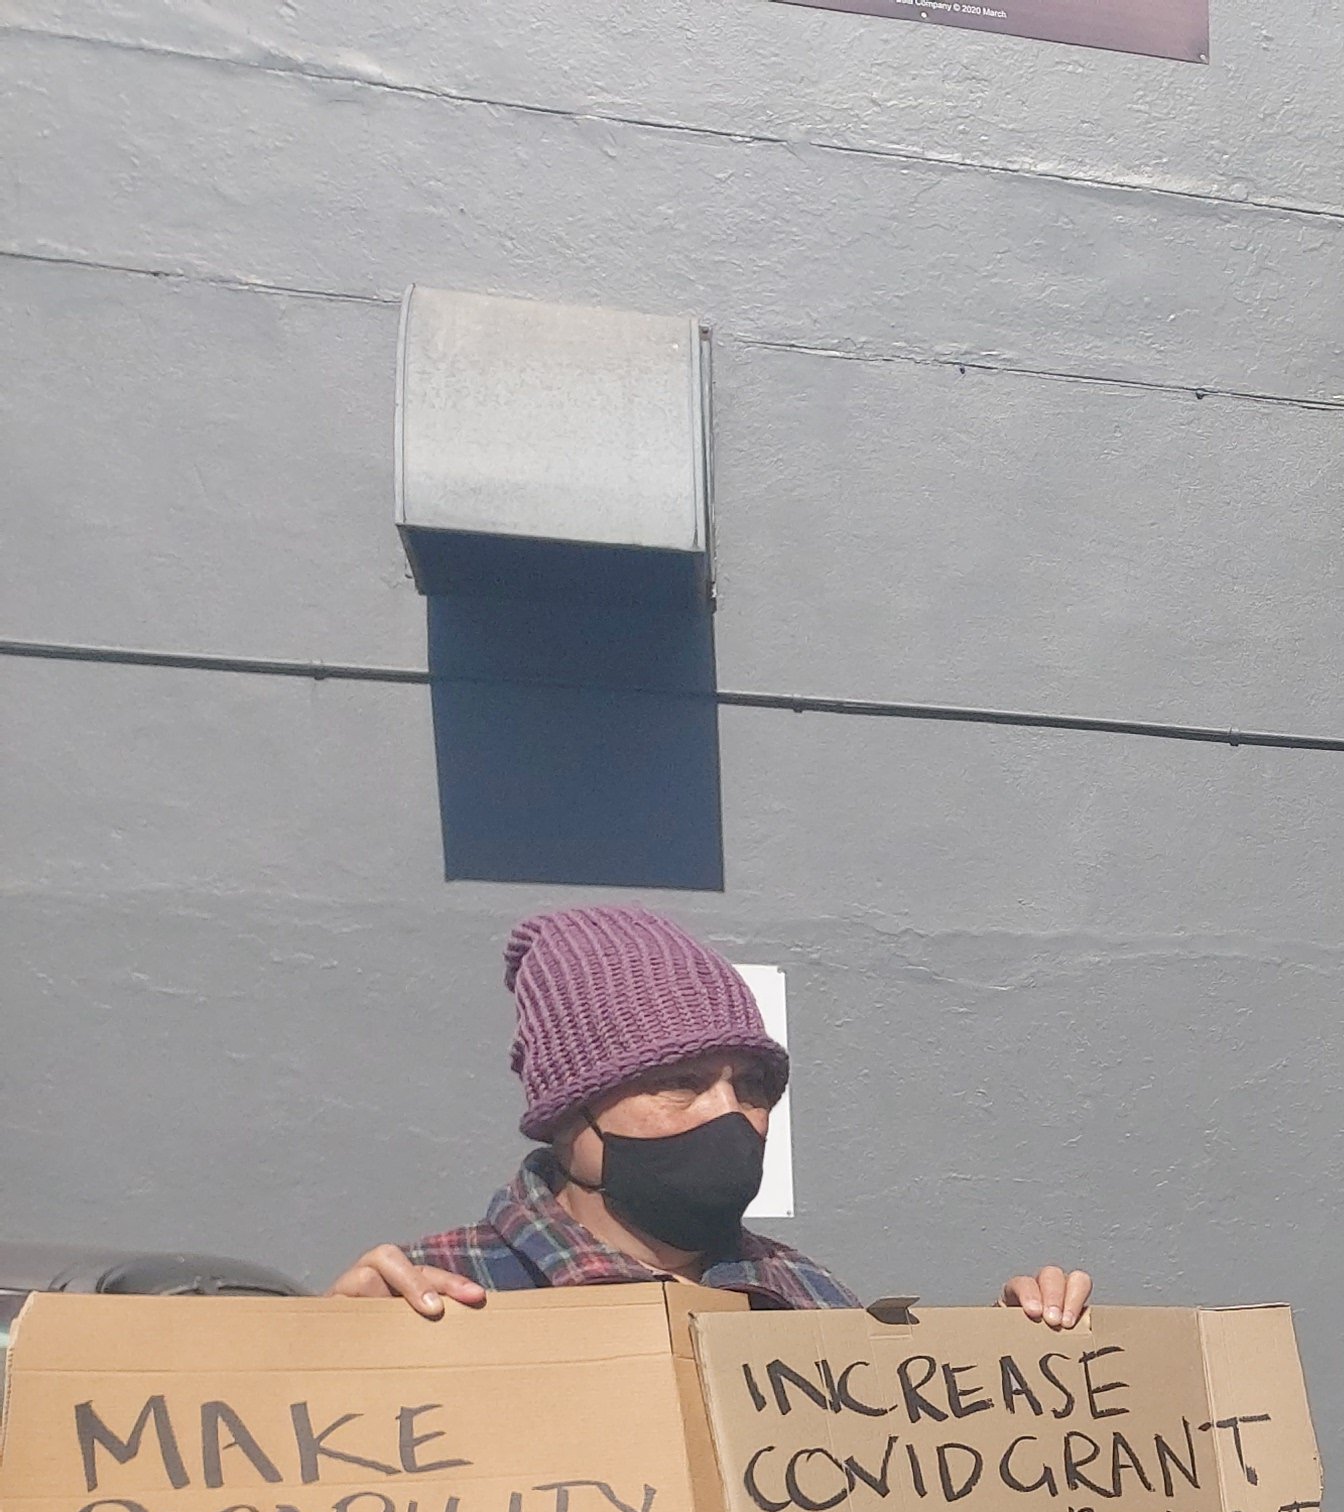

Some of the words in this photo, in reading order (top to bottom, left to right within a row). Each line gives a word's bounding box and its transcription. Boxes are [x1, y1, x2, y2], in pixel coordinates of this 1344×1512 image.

[962, 5, 981, 14] 2020
[982, 8, 1007, 18] March
[743, 1345, 1130, 1423] INCREASE
[74, 1395, 473, 1492] MAKE
[744, 1436, 983, 1512] COVID
